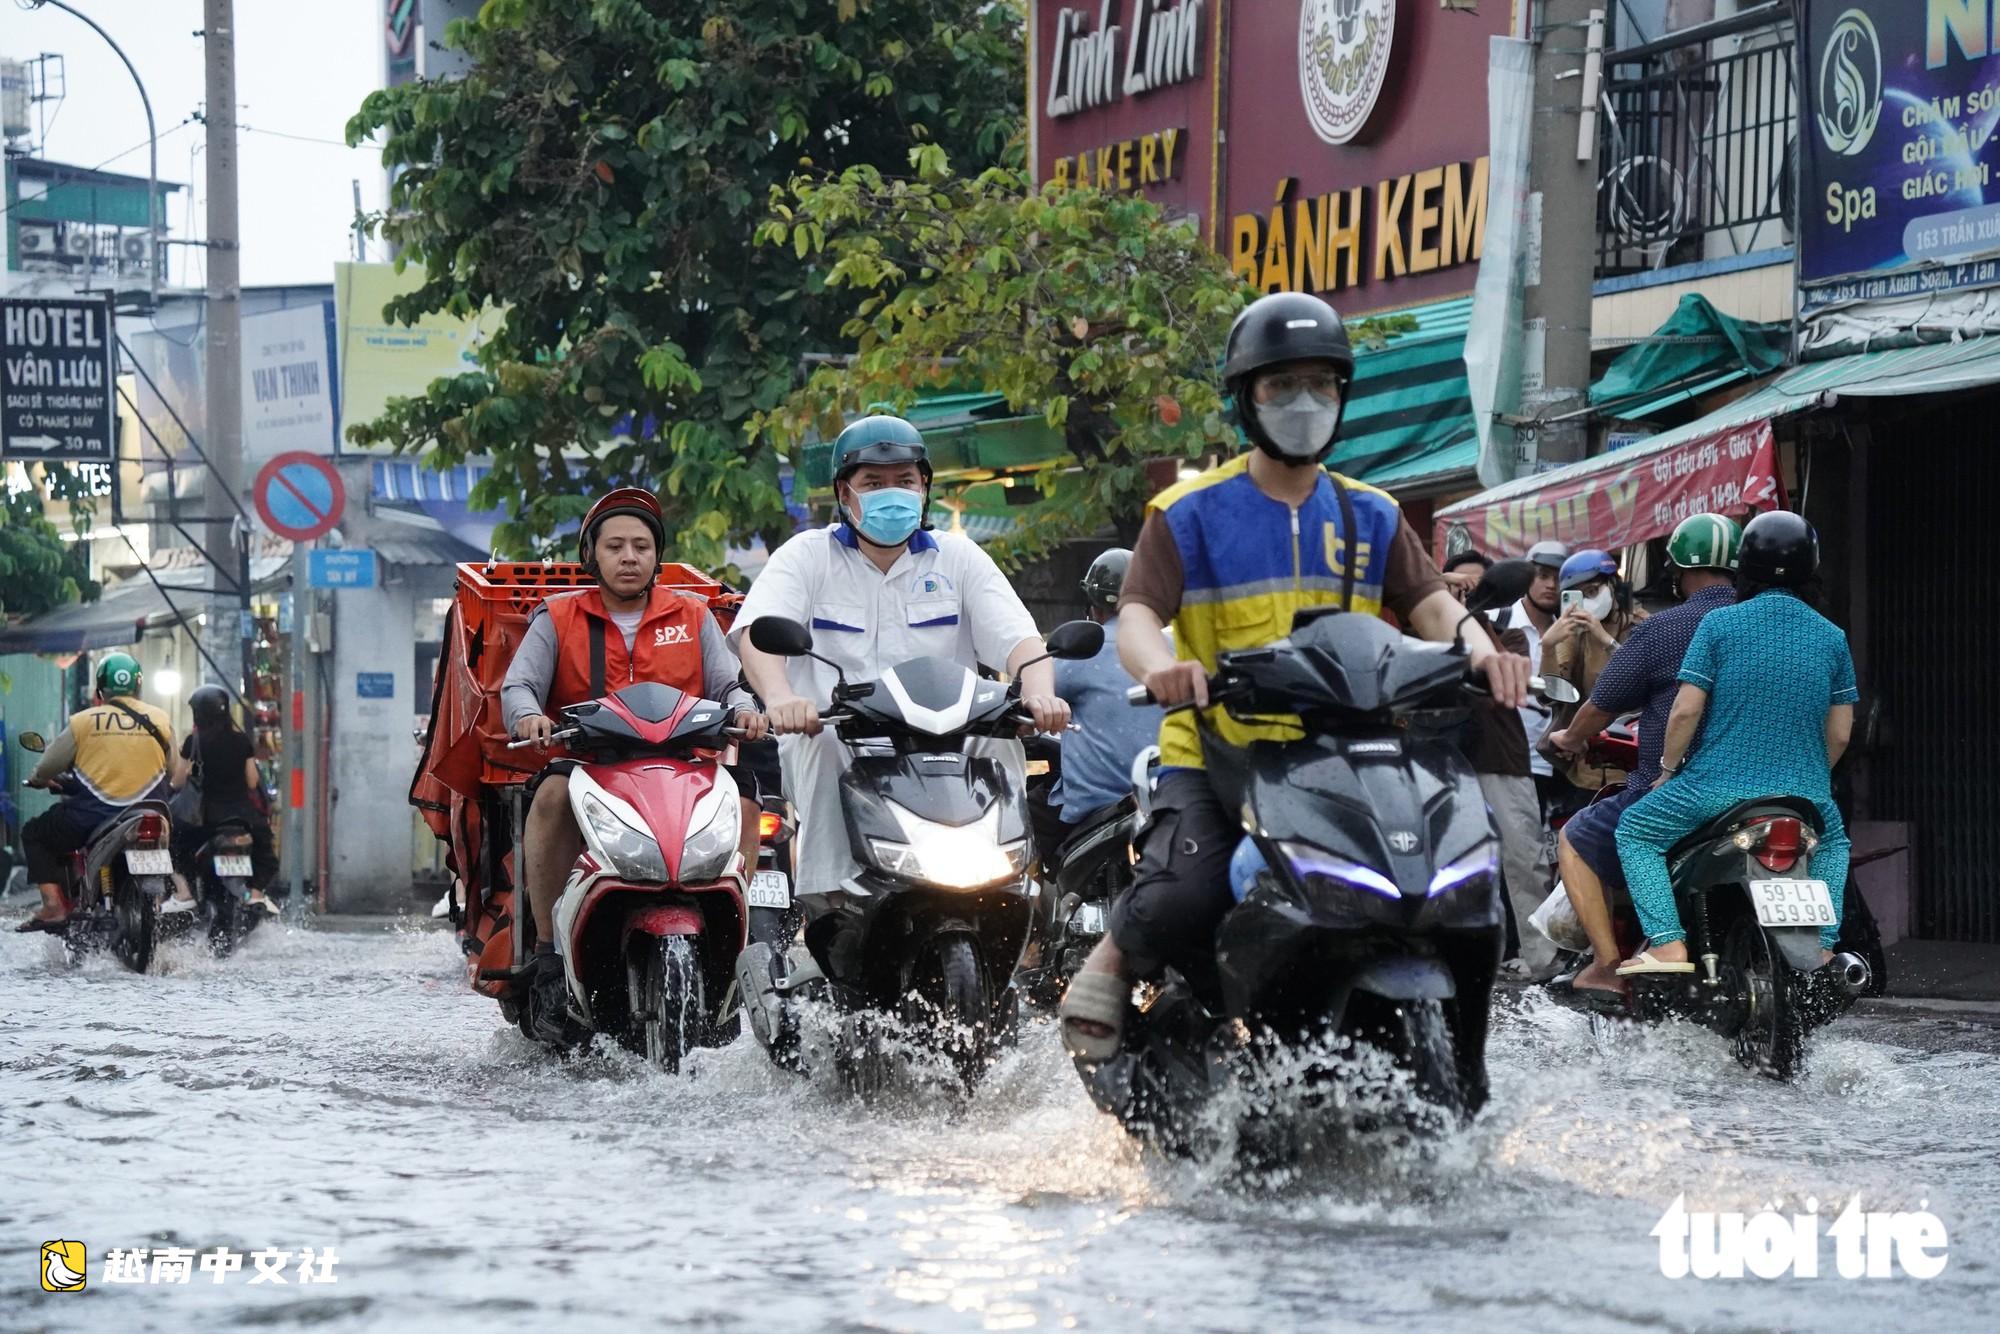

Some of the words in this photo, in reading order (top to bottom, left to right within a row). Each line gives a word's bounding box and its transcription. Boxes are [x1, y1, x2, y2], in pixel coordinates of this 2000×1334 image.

[1047, 0, 1122, 118] Linh
[1902, 96, 1961, 128] CHĂM
[1054, 128, 1179, 198] BAKERY
[1902, 134, 1937, 165] GỘI
[1902, 169, 1949, 200] GIÁC
[1826, 181, 1877, 233] Spa
[1229, 176, 1363, 295] BÁNH
[1375, 155, 1490, 281] KEM
[1917, 230, 1939, 252] 163
[5, 307, 102, 347] HOTEL
[36, 415, 70, 429] THANG
[73, 413, 95, 428] MÁY
[64, 436, 83, 450] 30
[86, 439, 101, 450] m
[1711, 481, 1741, 510] 149k
[655, 623, 689, 643] SPX
[1347, 743, 1397, 753] HONDA
[1763, 884, 1816, 902] 59-L1
[1762, 904, 1830, 923] 159.98
